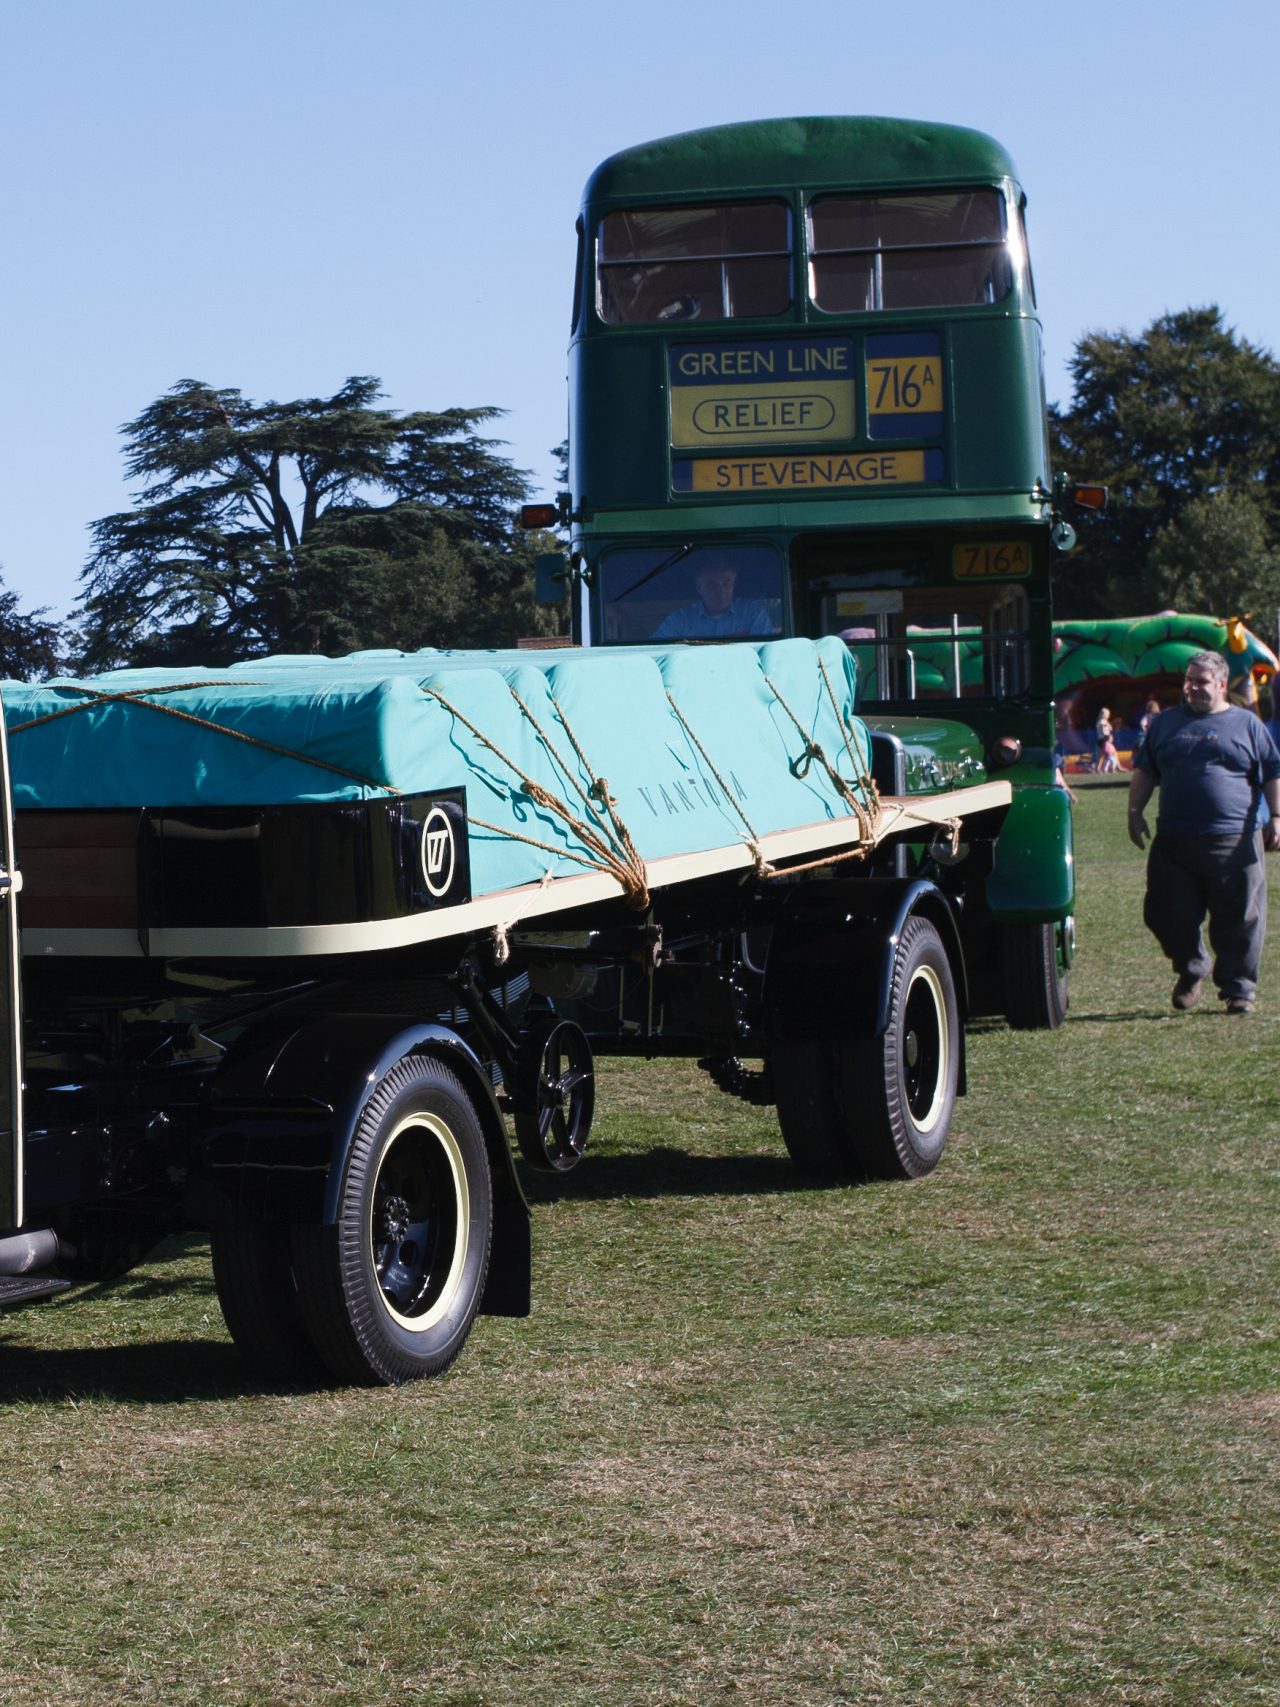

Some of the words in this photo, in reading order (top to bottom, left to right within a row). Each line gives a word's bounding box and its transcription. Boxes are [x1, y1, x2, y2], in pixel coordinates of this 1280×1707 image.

[678, 350, 775, 376] GREEN
[788, 347, 849, 373] LINE
[714, 402, 815, 428] RELIEF
[716, 456, 897, 488] STEVENAGE
